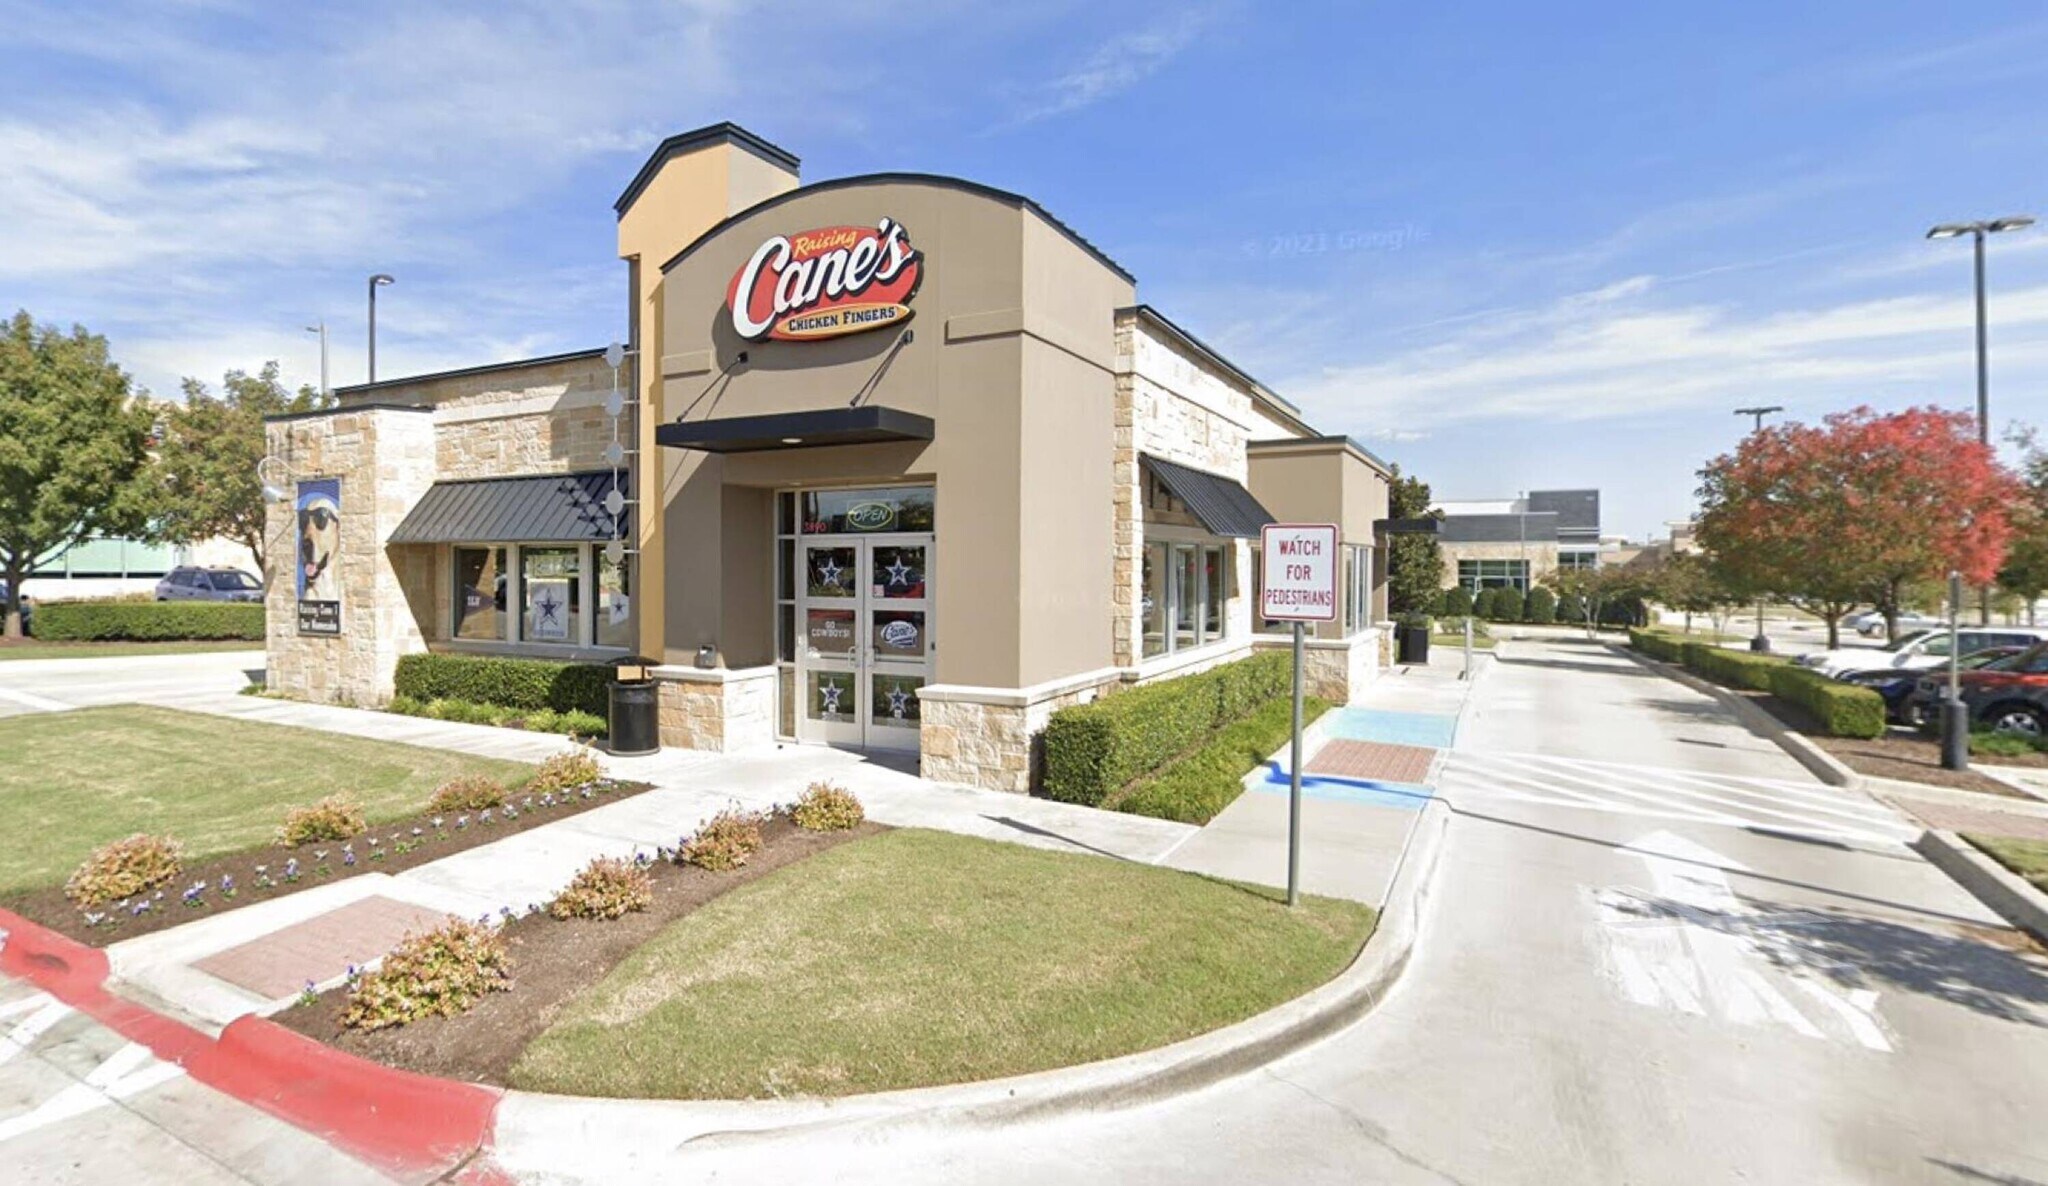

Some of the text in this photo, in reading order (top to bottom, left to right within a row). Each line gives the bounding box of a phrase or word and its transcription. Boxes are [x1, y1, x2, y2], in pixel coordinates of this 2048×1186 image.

[793, 229, 858, 259] Raising
[732, 217, 915, 338] Cane's
[788, 306, 896, 332] CHICKEN FINGERS
[853, 508, 888, 522] OPEN
[1278, 540, 1321, 555] WATCH
[1286, 564, 1312, 580] FOR
[1265, 589, 1332, 606] PEDESTRIANS
[825, 620, 836, 629] GO
